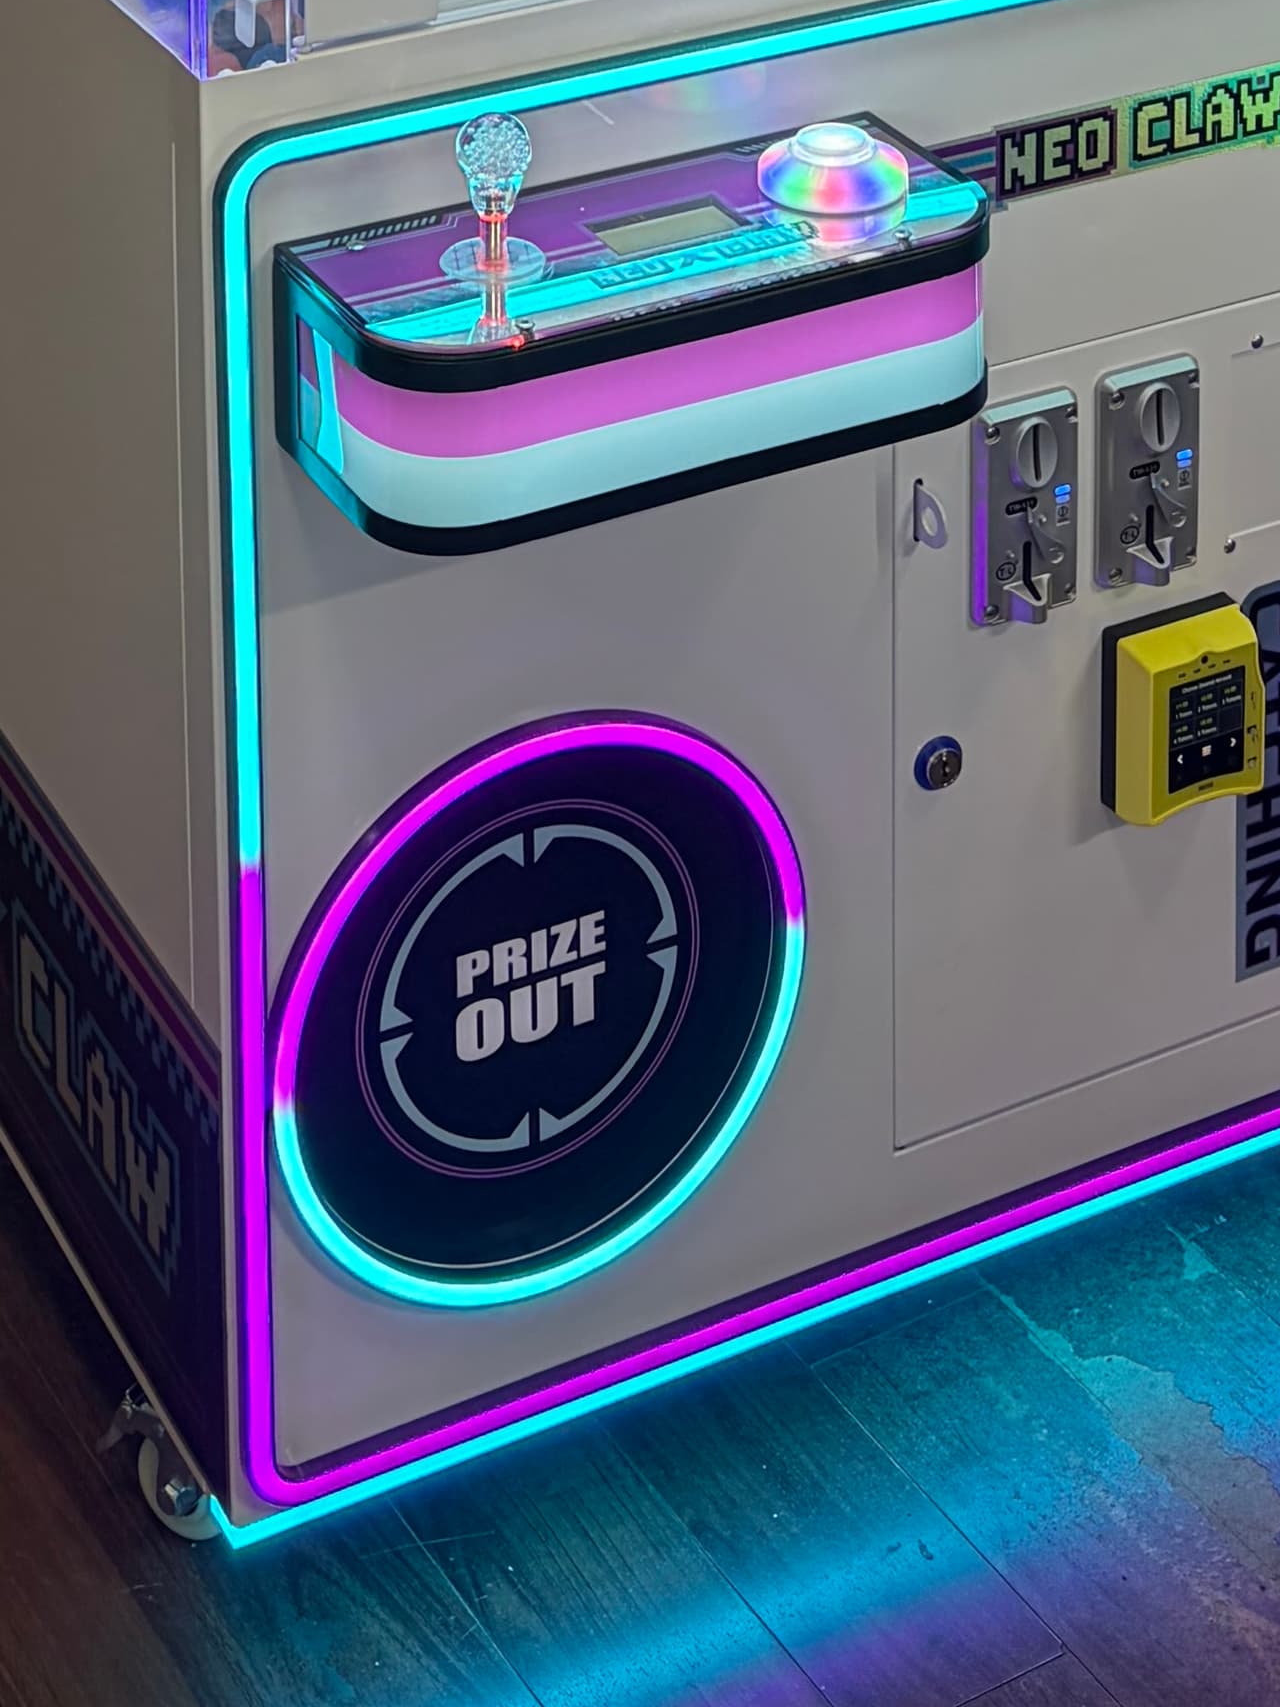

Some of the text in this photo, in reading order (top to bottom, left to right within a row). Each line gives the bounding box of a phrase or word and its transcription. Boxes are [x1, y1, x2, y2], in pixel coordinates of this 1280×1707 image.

[1003, 122, 1111, 190] NEO
[456, 909, 607, 999] PRIZE
[455, 960, 606, 1062] OUT
[20, 919, 173, 1267] CLAW
